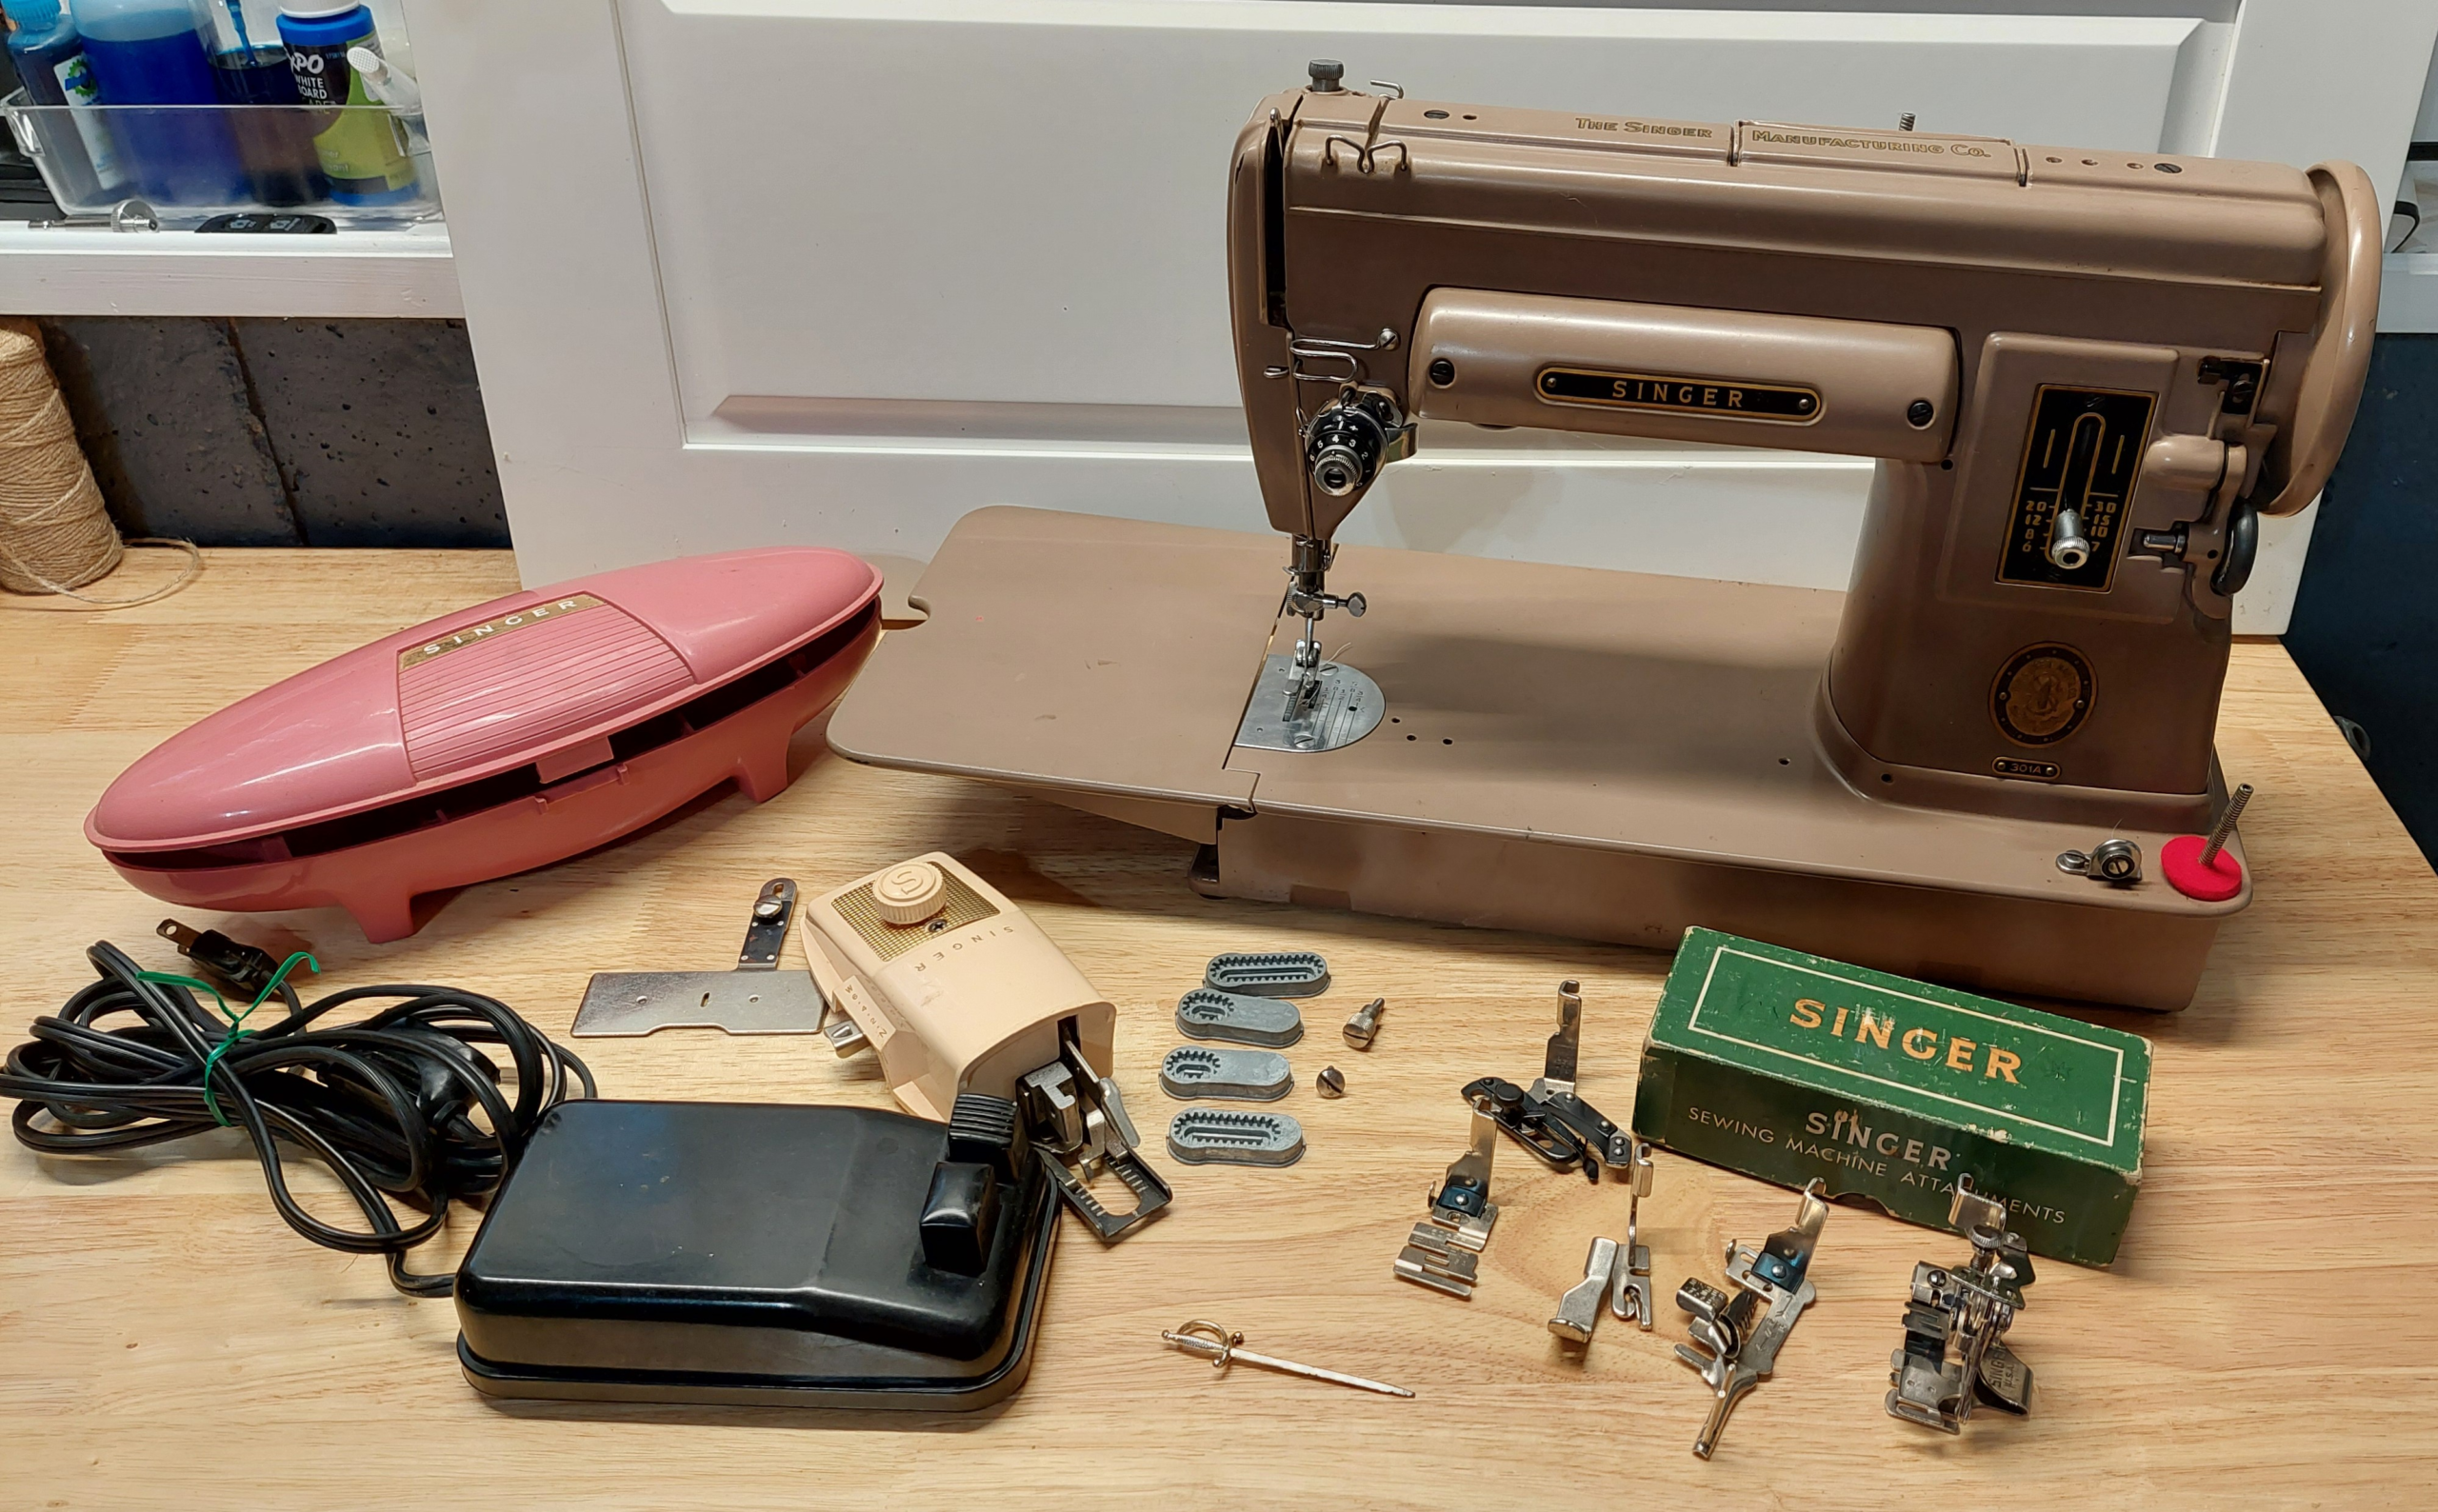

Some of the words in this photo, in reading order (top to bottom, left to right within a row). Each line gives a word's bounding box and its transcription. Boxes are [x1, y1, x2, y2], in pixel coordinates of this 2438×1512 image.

[1575, 117, 1618, 131] THE
[1624, 121, 1712, 138] SINGER
[1751, 129, 1945, 153] MANUFACTURING
[1611, 381, 1743, 408] SINGER
[2025, 500, 2047, 512] 20
[2094, 501, 2117, 513] 30
[2025, 514, 2042, 526] 12
[2093, 514, 2111, 526] 15
[2025, 528, 2034, 540] 8
[2090, 526, 2108, 538] 10
[2022, 541, 2032, 552] 6
[2090, 541, 2101, 552] 7
[423, 600, 577, 655] SINGER
[2009, 763, 2042, 774] 301A
[914, 925, 1014, 972] SINGER
[1789, 997, 2022, 1084] SINGER
[1688, 1105, 1775, 1143] SEWING
[1785, 1137, 1888, 1178] MACHINE
[1805, 1110, 1952, 1171] SINGER
